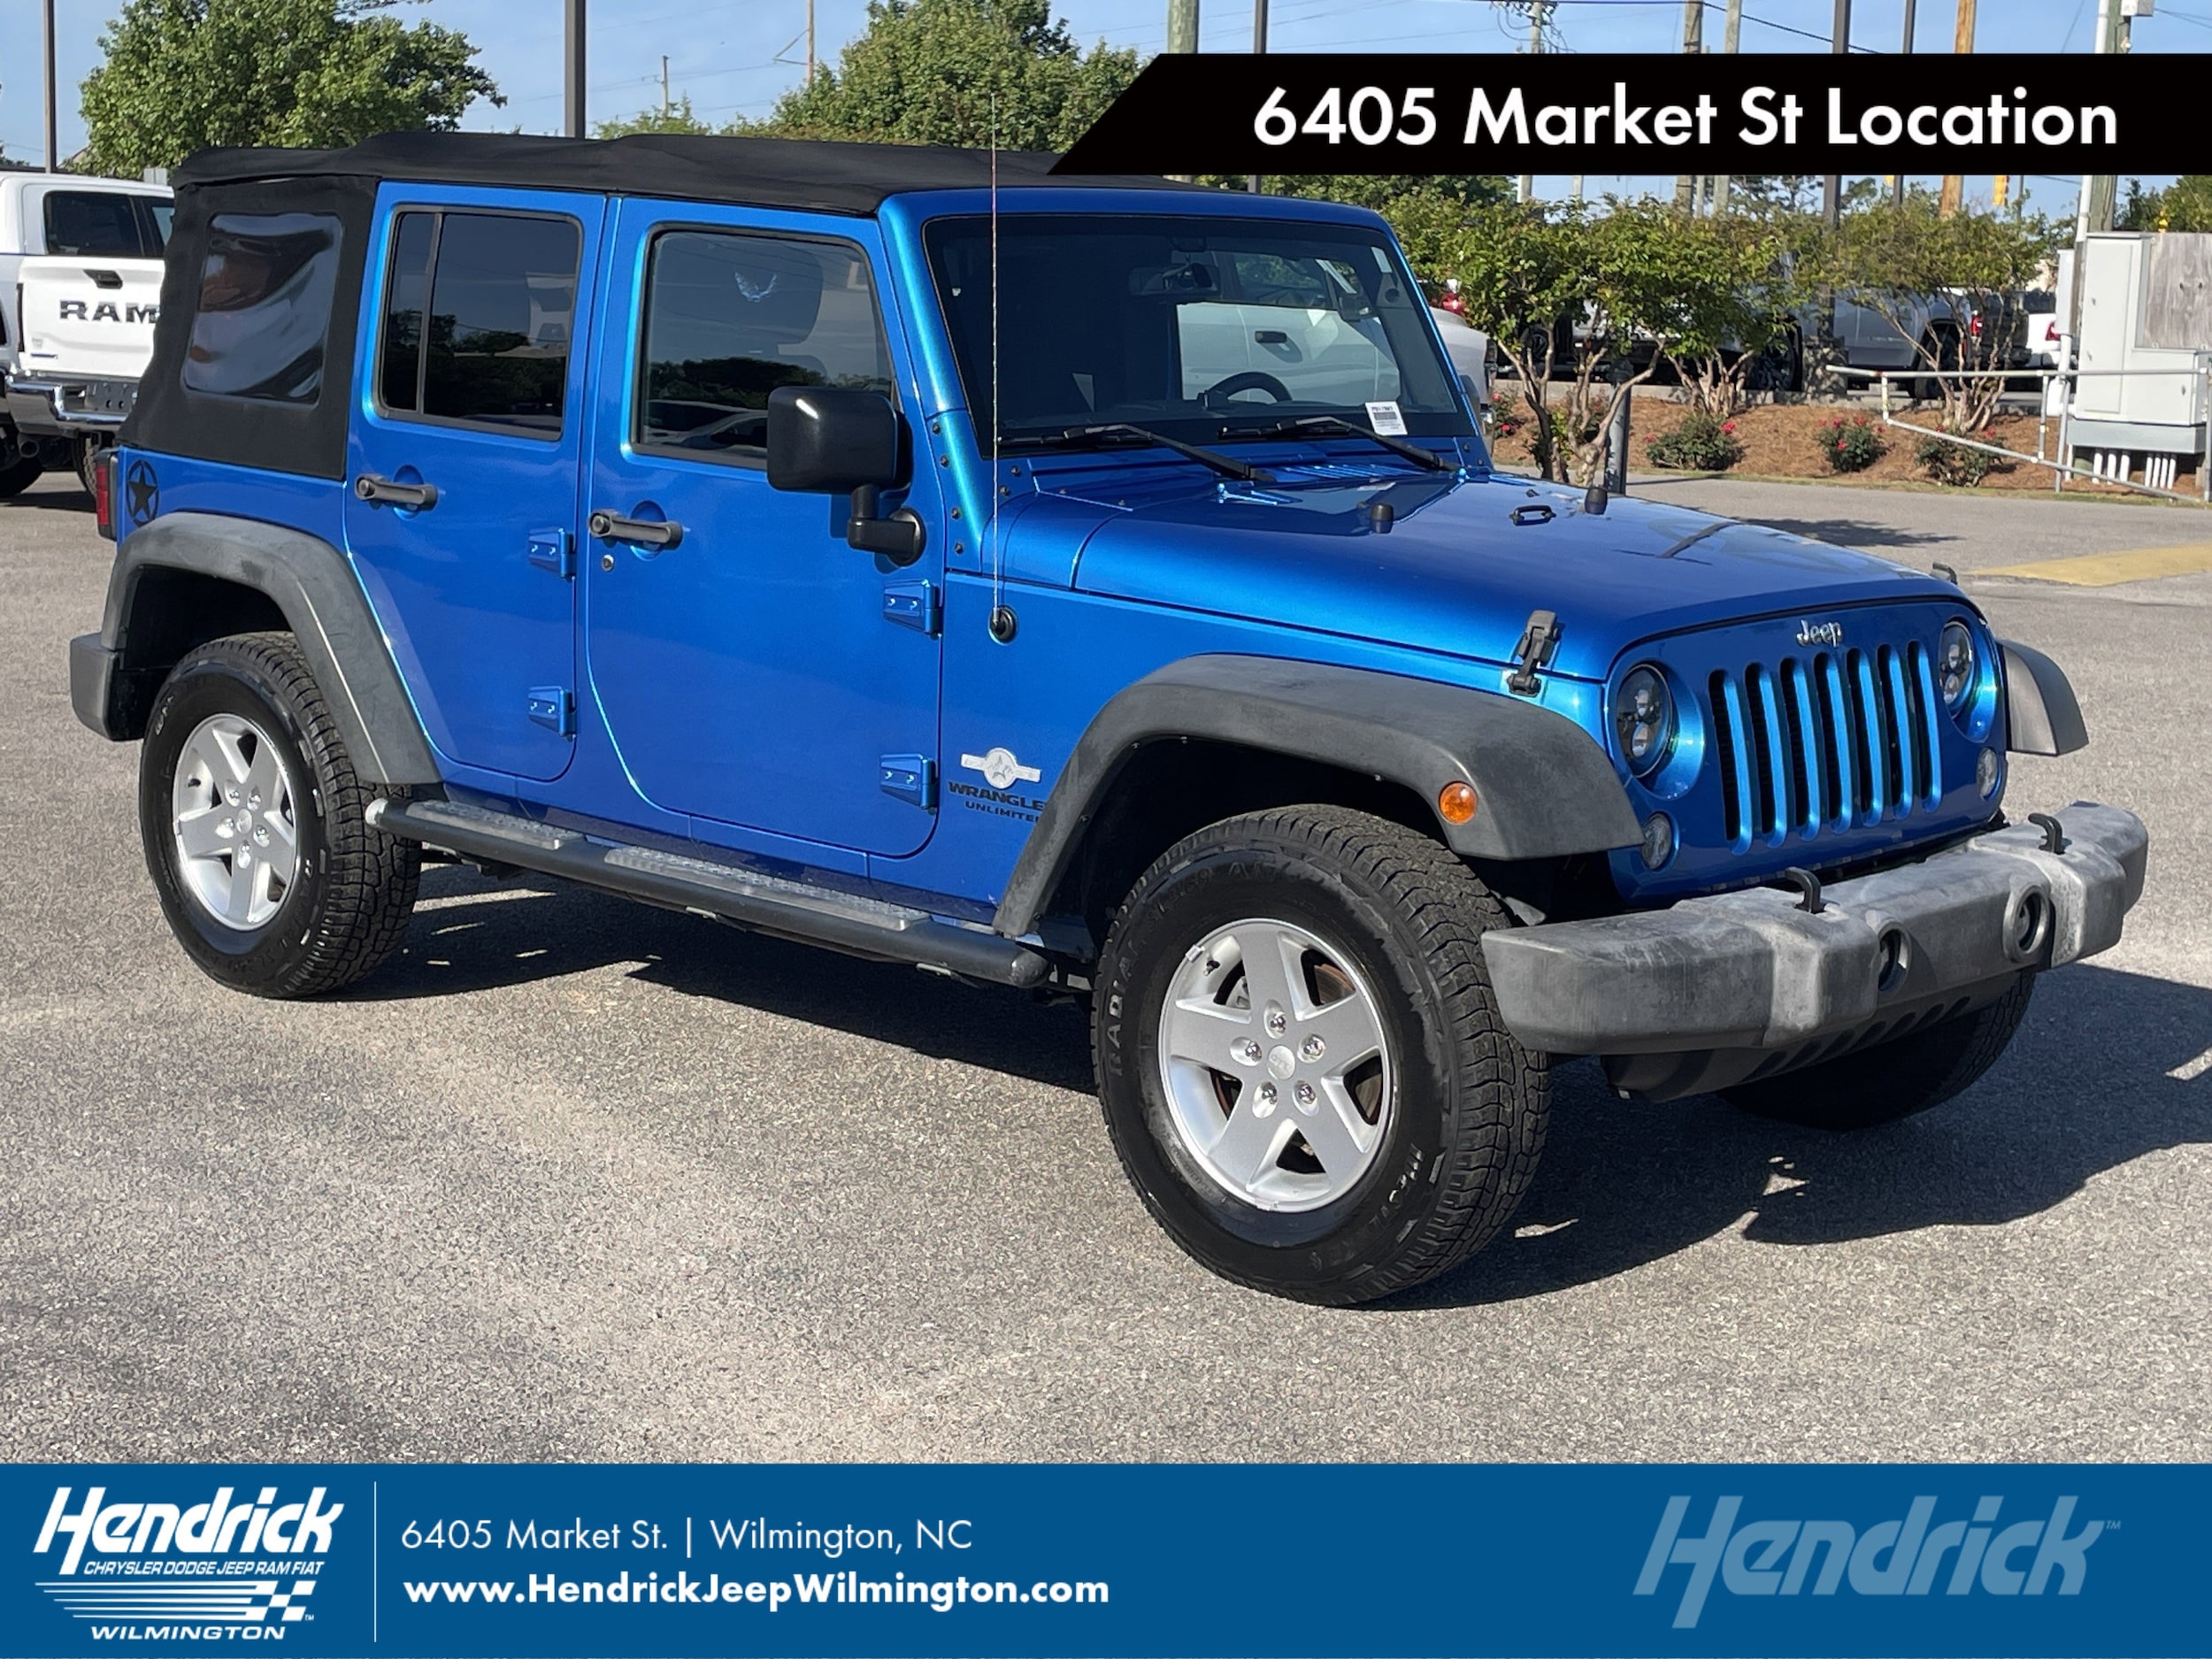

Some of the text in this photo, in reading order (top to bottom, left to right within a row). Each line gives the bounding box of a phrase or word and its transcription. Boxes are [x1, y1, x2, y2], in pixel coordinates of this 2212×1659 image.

[59, 299, 159, 324] RAM
[1796, 619, 1841, 648] Jeep
[949, 781, 1046, 811] WRANGLE
[965, 801, 1041, 823] UNLIMITE
